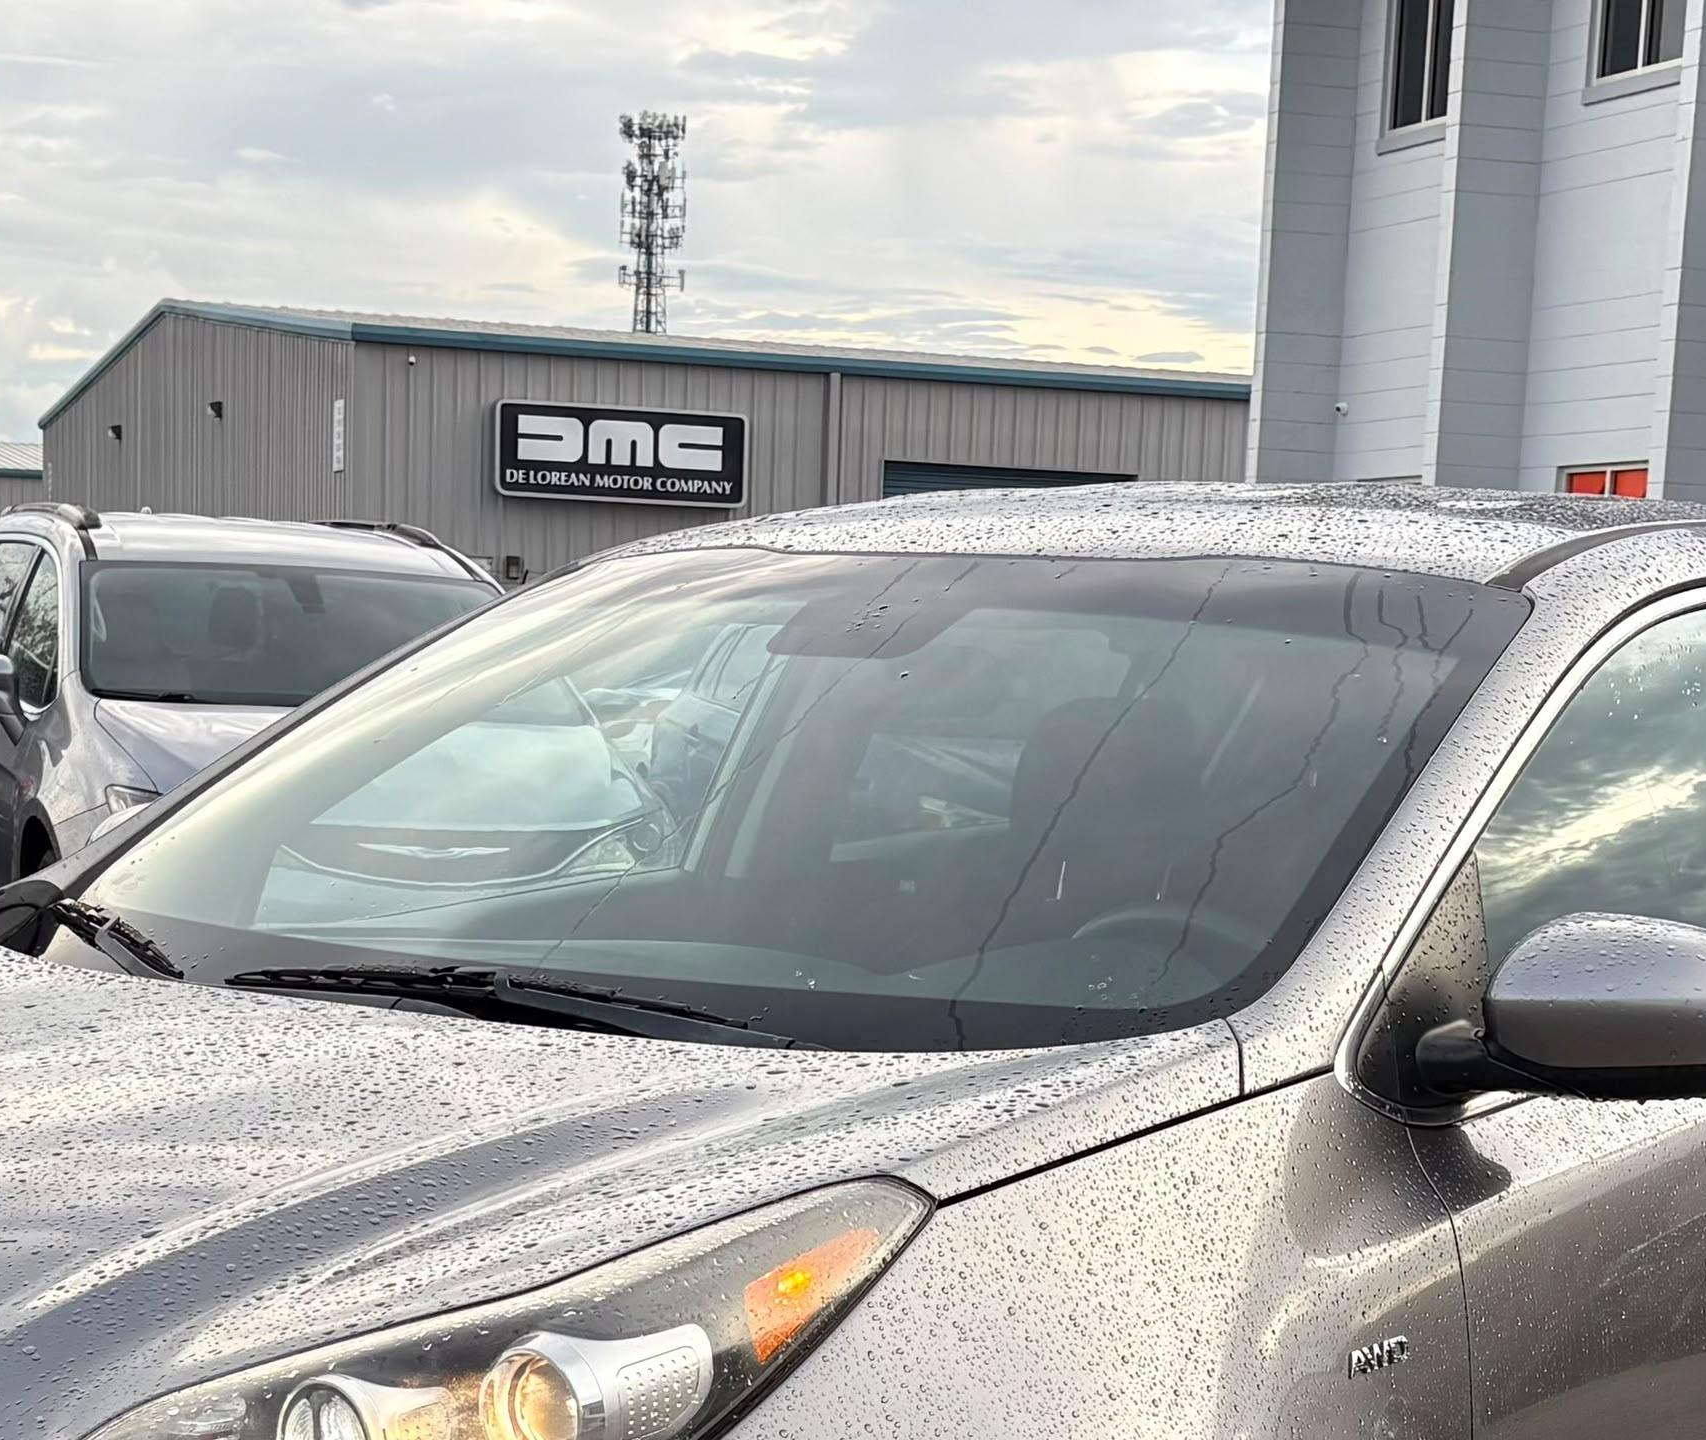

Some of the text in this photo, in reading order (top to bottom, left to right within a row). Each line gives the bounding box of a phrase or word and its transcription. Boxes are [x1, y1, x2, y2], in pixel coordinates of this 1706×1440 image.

[517, 414, 724, 472] DMC
[594, 474, 652, 491] MOTOR
[656, 477, 733, 496] COMPANY
